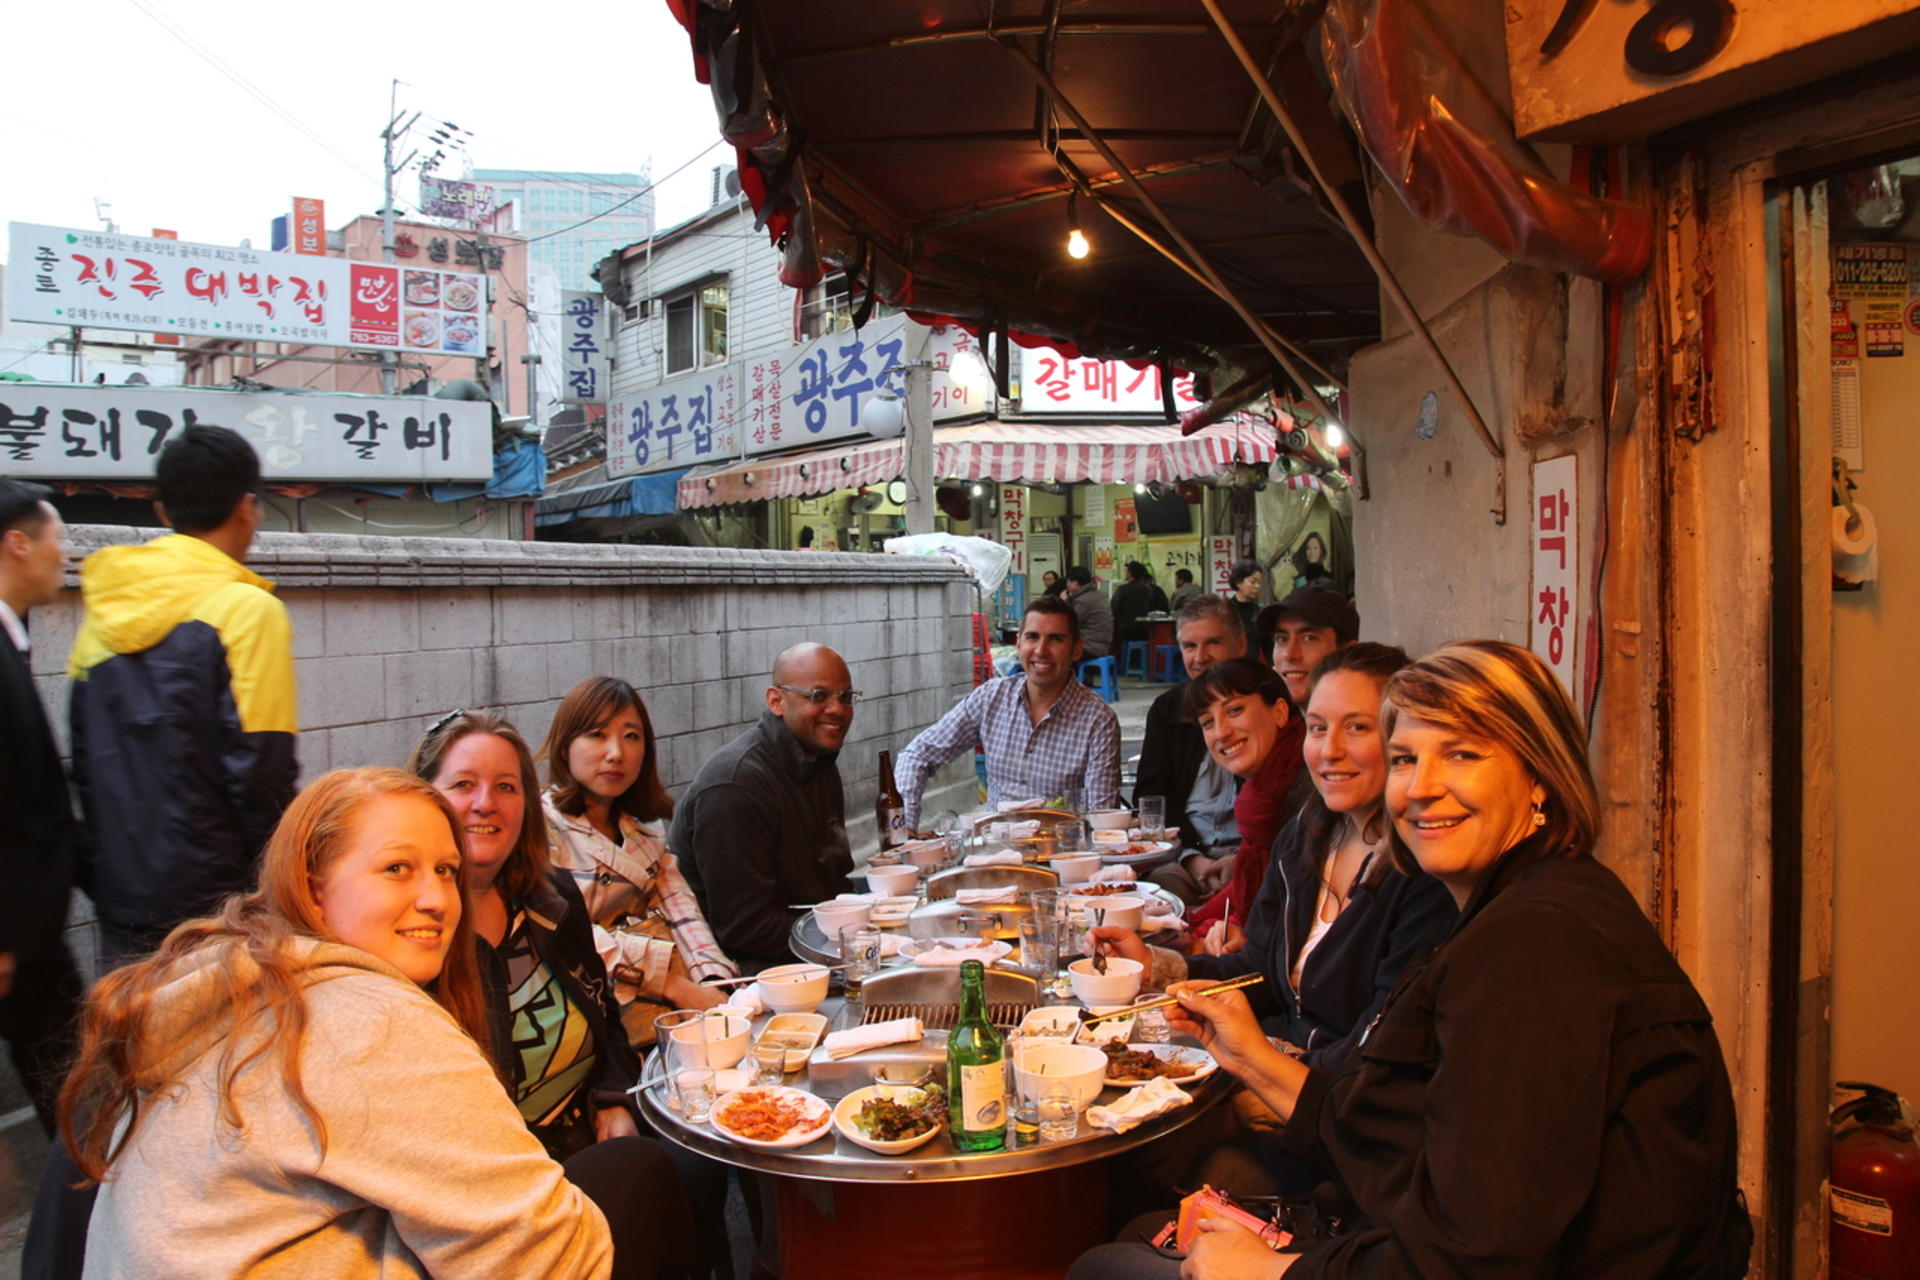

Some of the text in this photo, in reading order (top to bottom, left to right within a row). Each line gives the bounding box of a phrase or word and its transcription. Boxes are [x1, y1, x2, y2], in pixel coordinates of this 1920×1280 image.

[35, 246, 60, 293] 종로
[70, 253, 327, 326] 진주 대박집
[567, 298, 600, 398] 광주집
[246, 404, 317, 469] 왕
[334, 409, 451, 461] 갈비
[628, 384, 712, 466] 광주집
[1539, 489, 1569, 664] 막창
